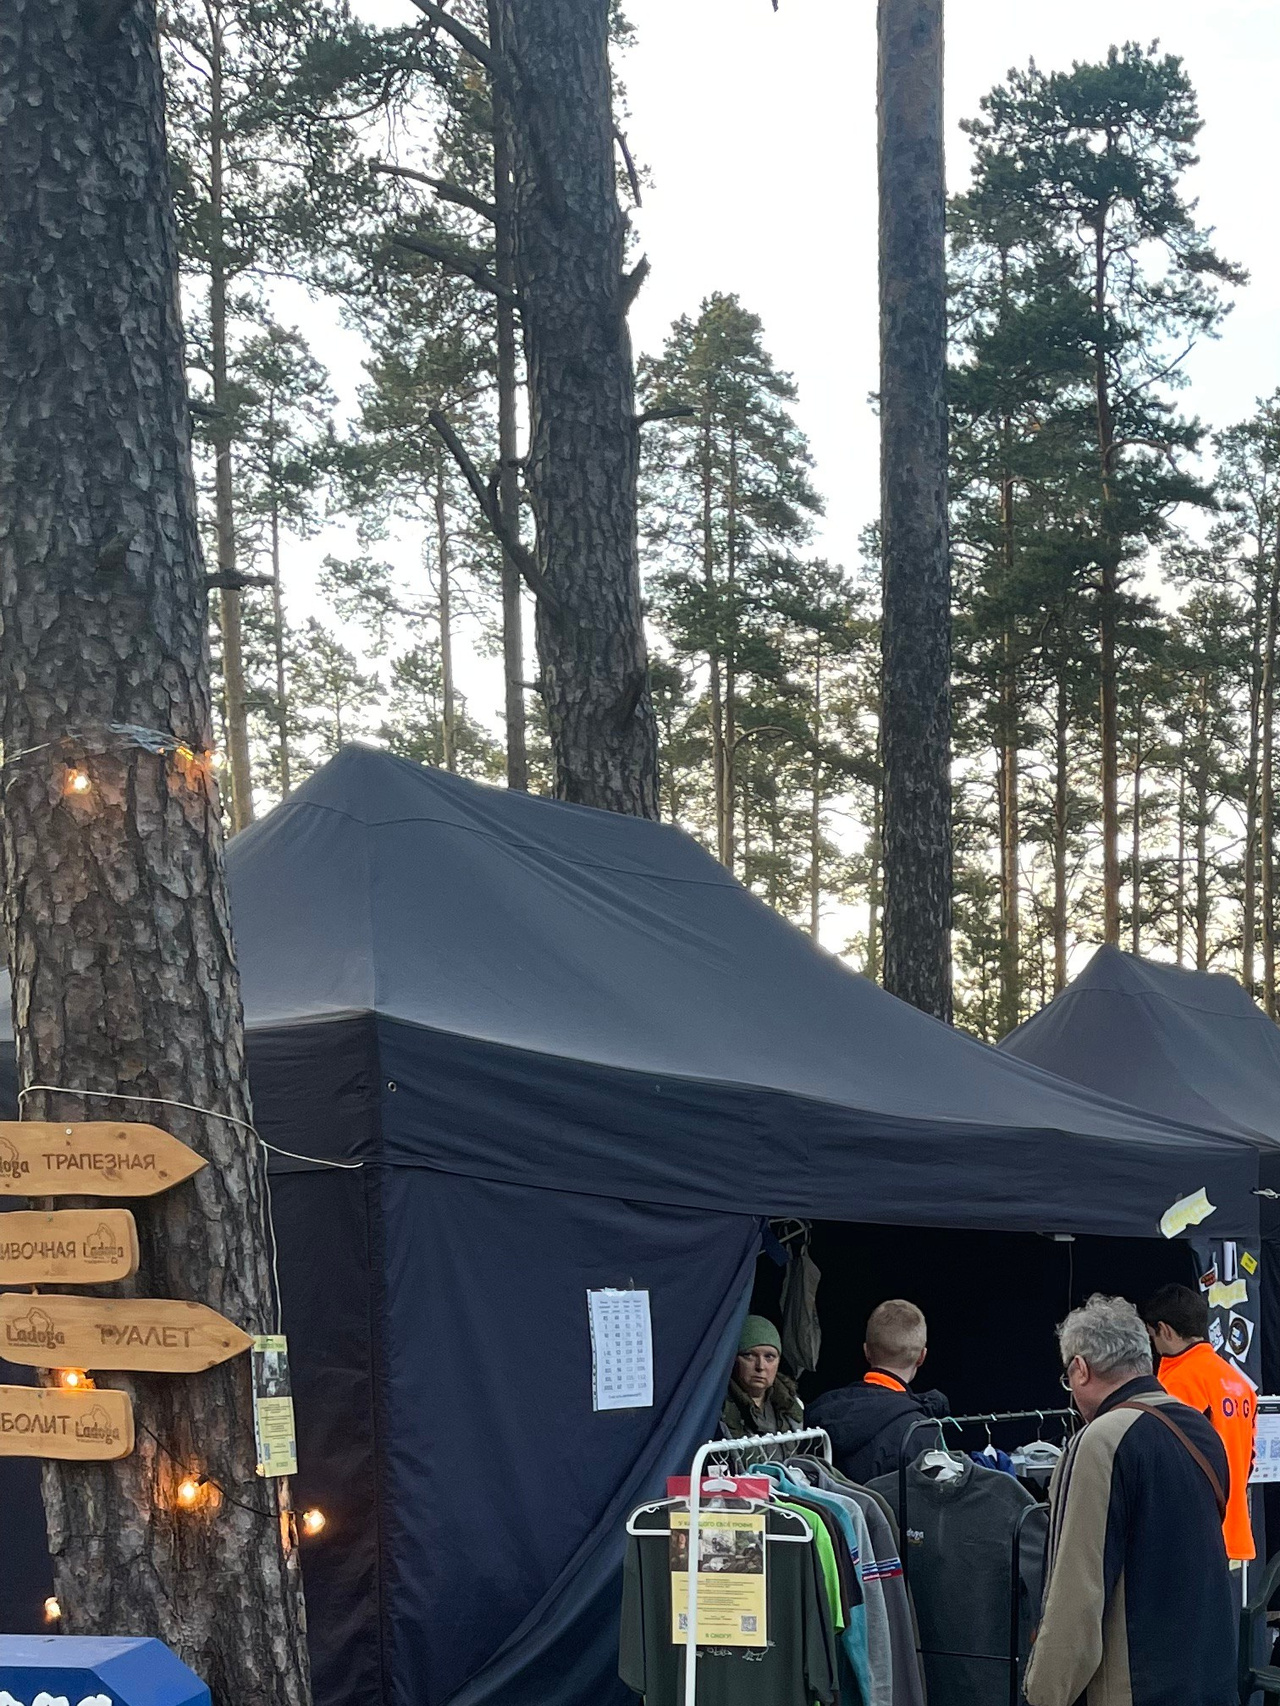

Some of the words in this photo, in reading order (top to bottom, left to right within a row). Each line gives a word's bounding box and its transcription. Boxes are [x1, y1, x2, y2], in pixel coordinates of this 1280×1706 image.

[42, 1153, 156, 1170] ТРАПЕЗНАЯ
[6, 1323, 65, 1349] Ladoga
[94, 1323, 196, 1348] ТУАЛЕТ
